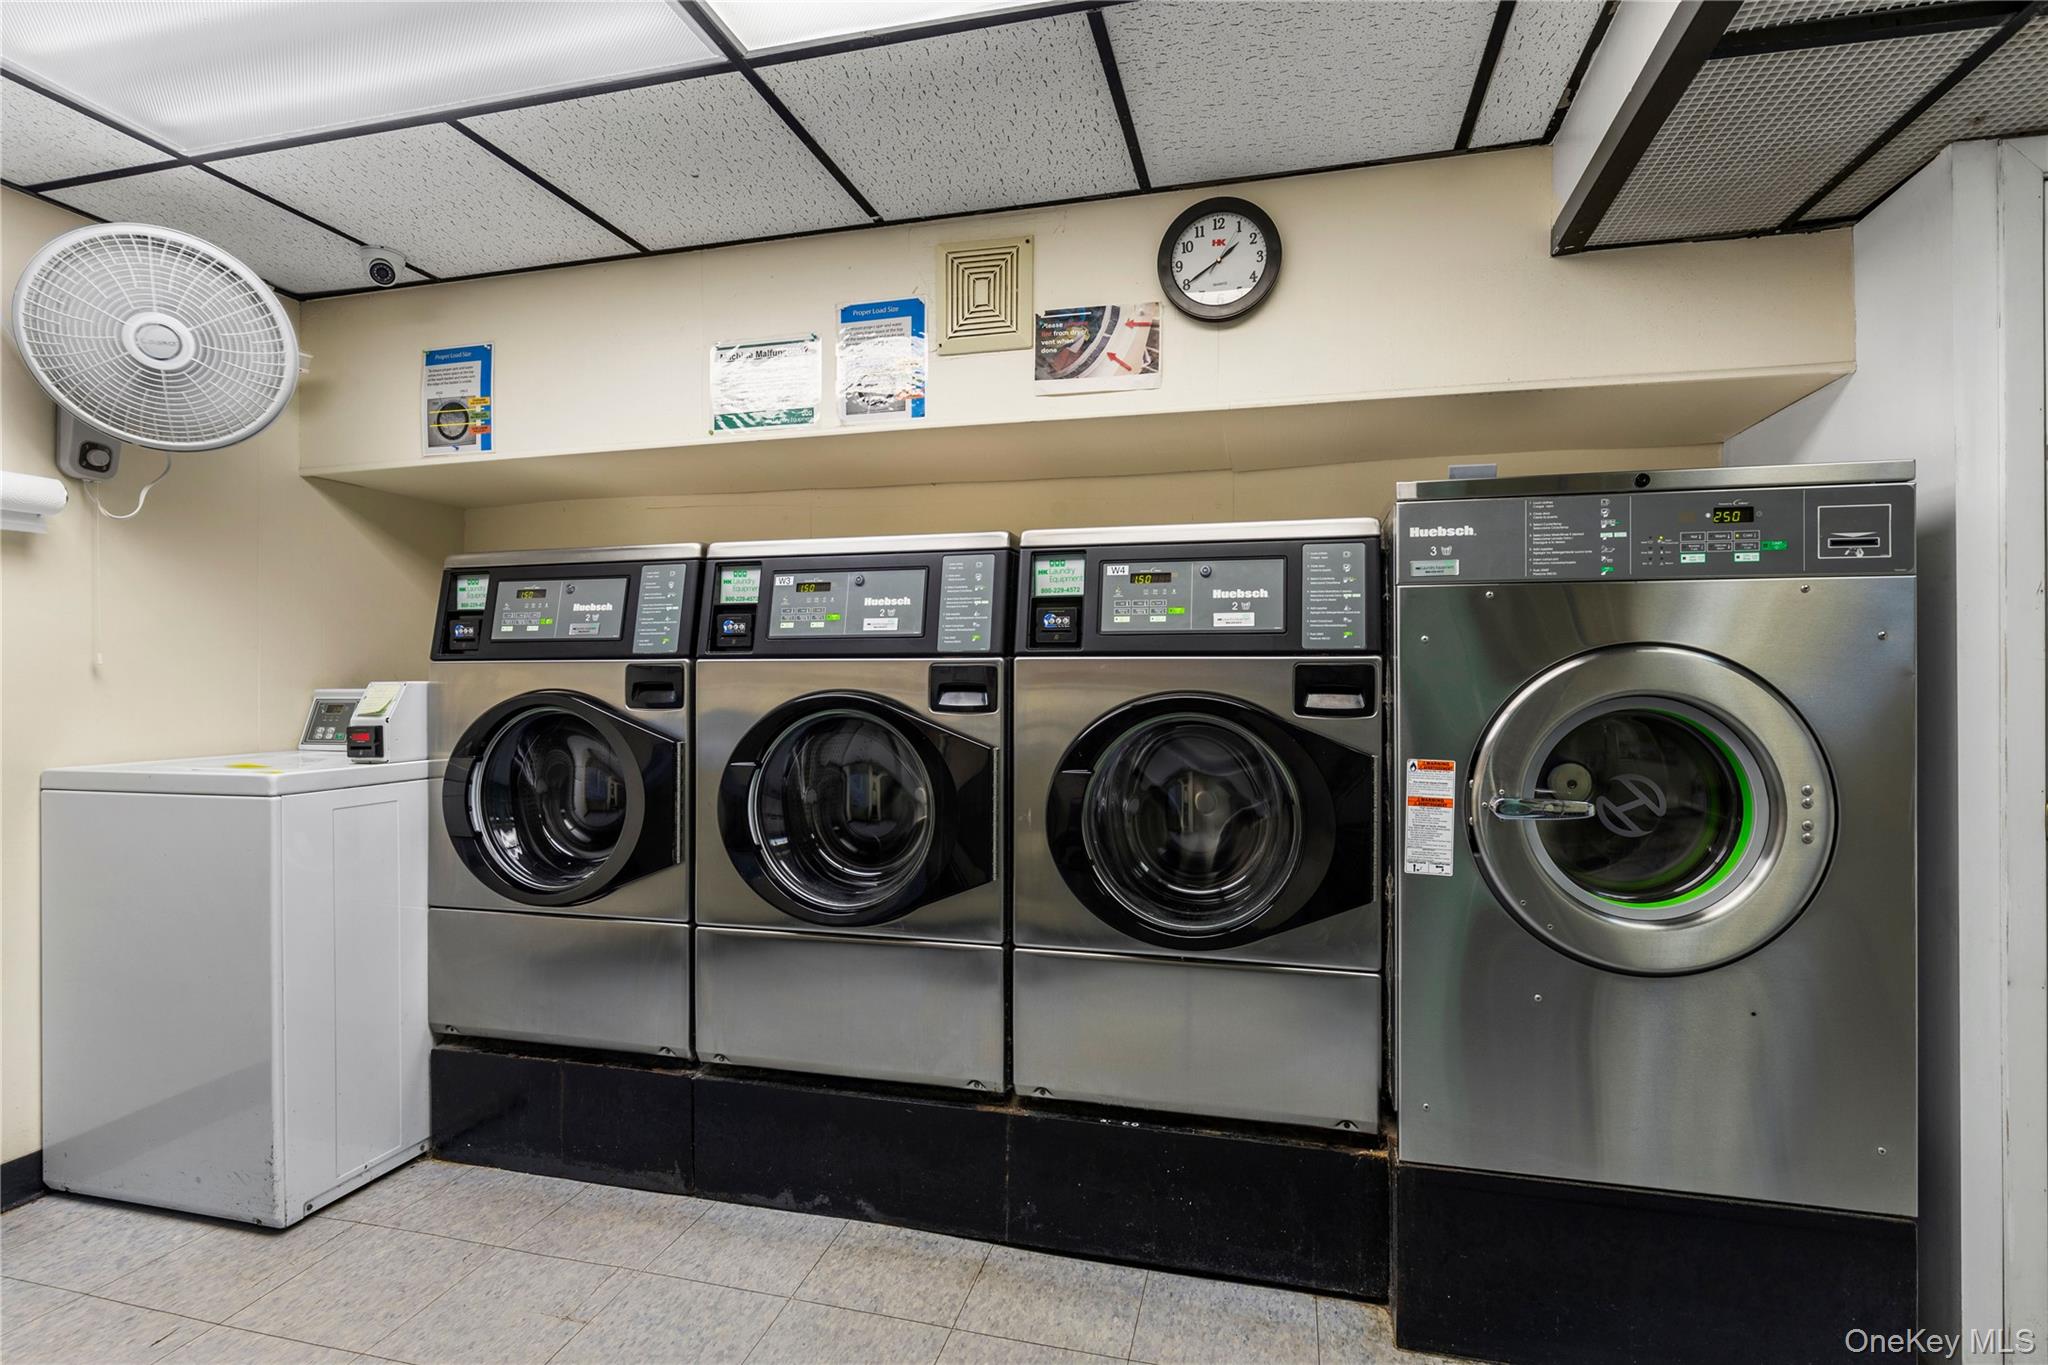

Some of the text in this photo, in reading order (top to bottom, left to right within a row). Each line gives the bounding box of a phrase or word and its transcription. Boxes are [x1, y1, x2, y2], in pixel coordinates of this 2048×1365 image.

[1213, 218, 1225, 230] 12
[1236, 221, 1242, 232] 1
[1195, 226, 1205, 238] 11
[1249, 232, 1257, 245] 2
[1182, 241, 1194, 253] 10
[1256, 250, 1264, 263] 3
[1175, 260, 1183, 273] 9
[1249, 271, 1258, 283] 4
[1182, 278, 1191, 291] 8
[852, 309, 872, 318] Proper
[1713, 511, 1741, 523] 250
[1409, 525, 1474, 538] Huebsch
[1429, 545, 1437, 556] 3
[1049, 567, 1076, 576] Laundry
[1111, 566, 1126, 574] W4
[778, 576, 791, 585] W3
[1049, 575, 1084, 583] Equipment
[1212, 588, 1268, 599] Huebsch
[864, 596, 911, 606] Huebsch
[1231, 601, 1238, 611] 2
[573, 602, 613, 612] Huebsch
[879, 608, 885, 617] 2
[585, 613, 591, 622] 2
